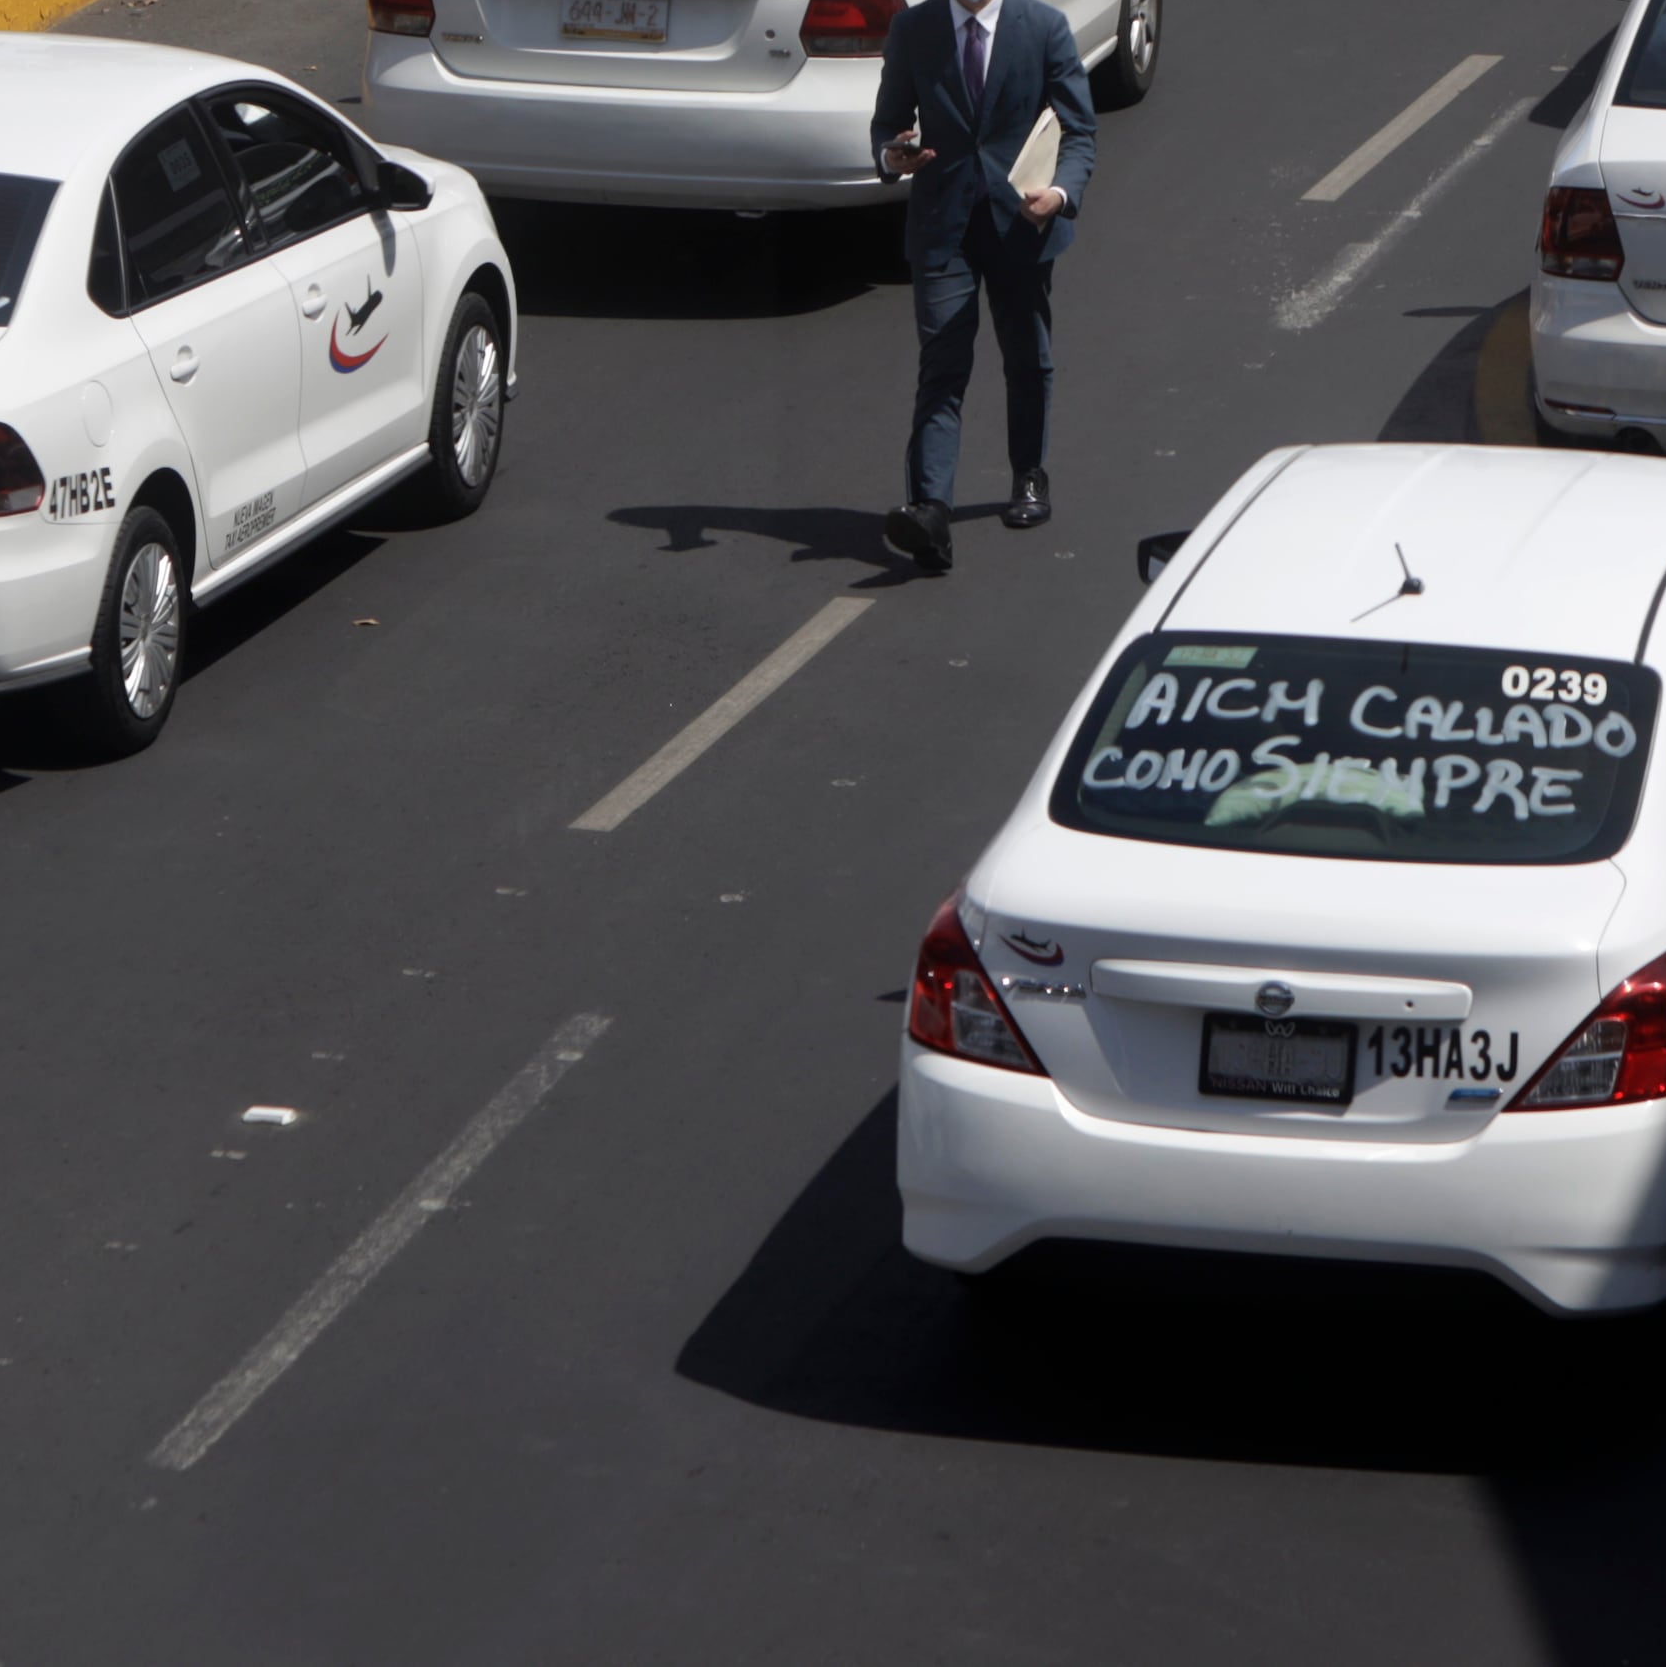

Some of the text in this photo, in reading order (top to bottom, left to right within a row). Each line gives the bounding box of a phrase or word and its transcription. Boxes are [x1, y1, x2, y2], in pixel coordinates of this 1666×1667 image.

[48, 467, 116, 519] 47HB2E
[1502, 666, 1608, 704] 0239
[1350, 686, 1636, 757] CALLADO
[1250, 736, 1583, 820] SIEMPRE
[1369, 1025, 1519, 1083] 13HA3J
